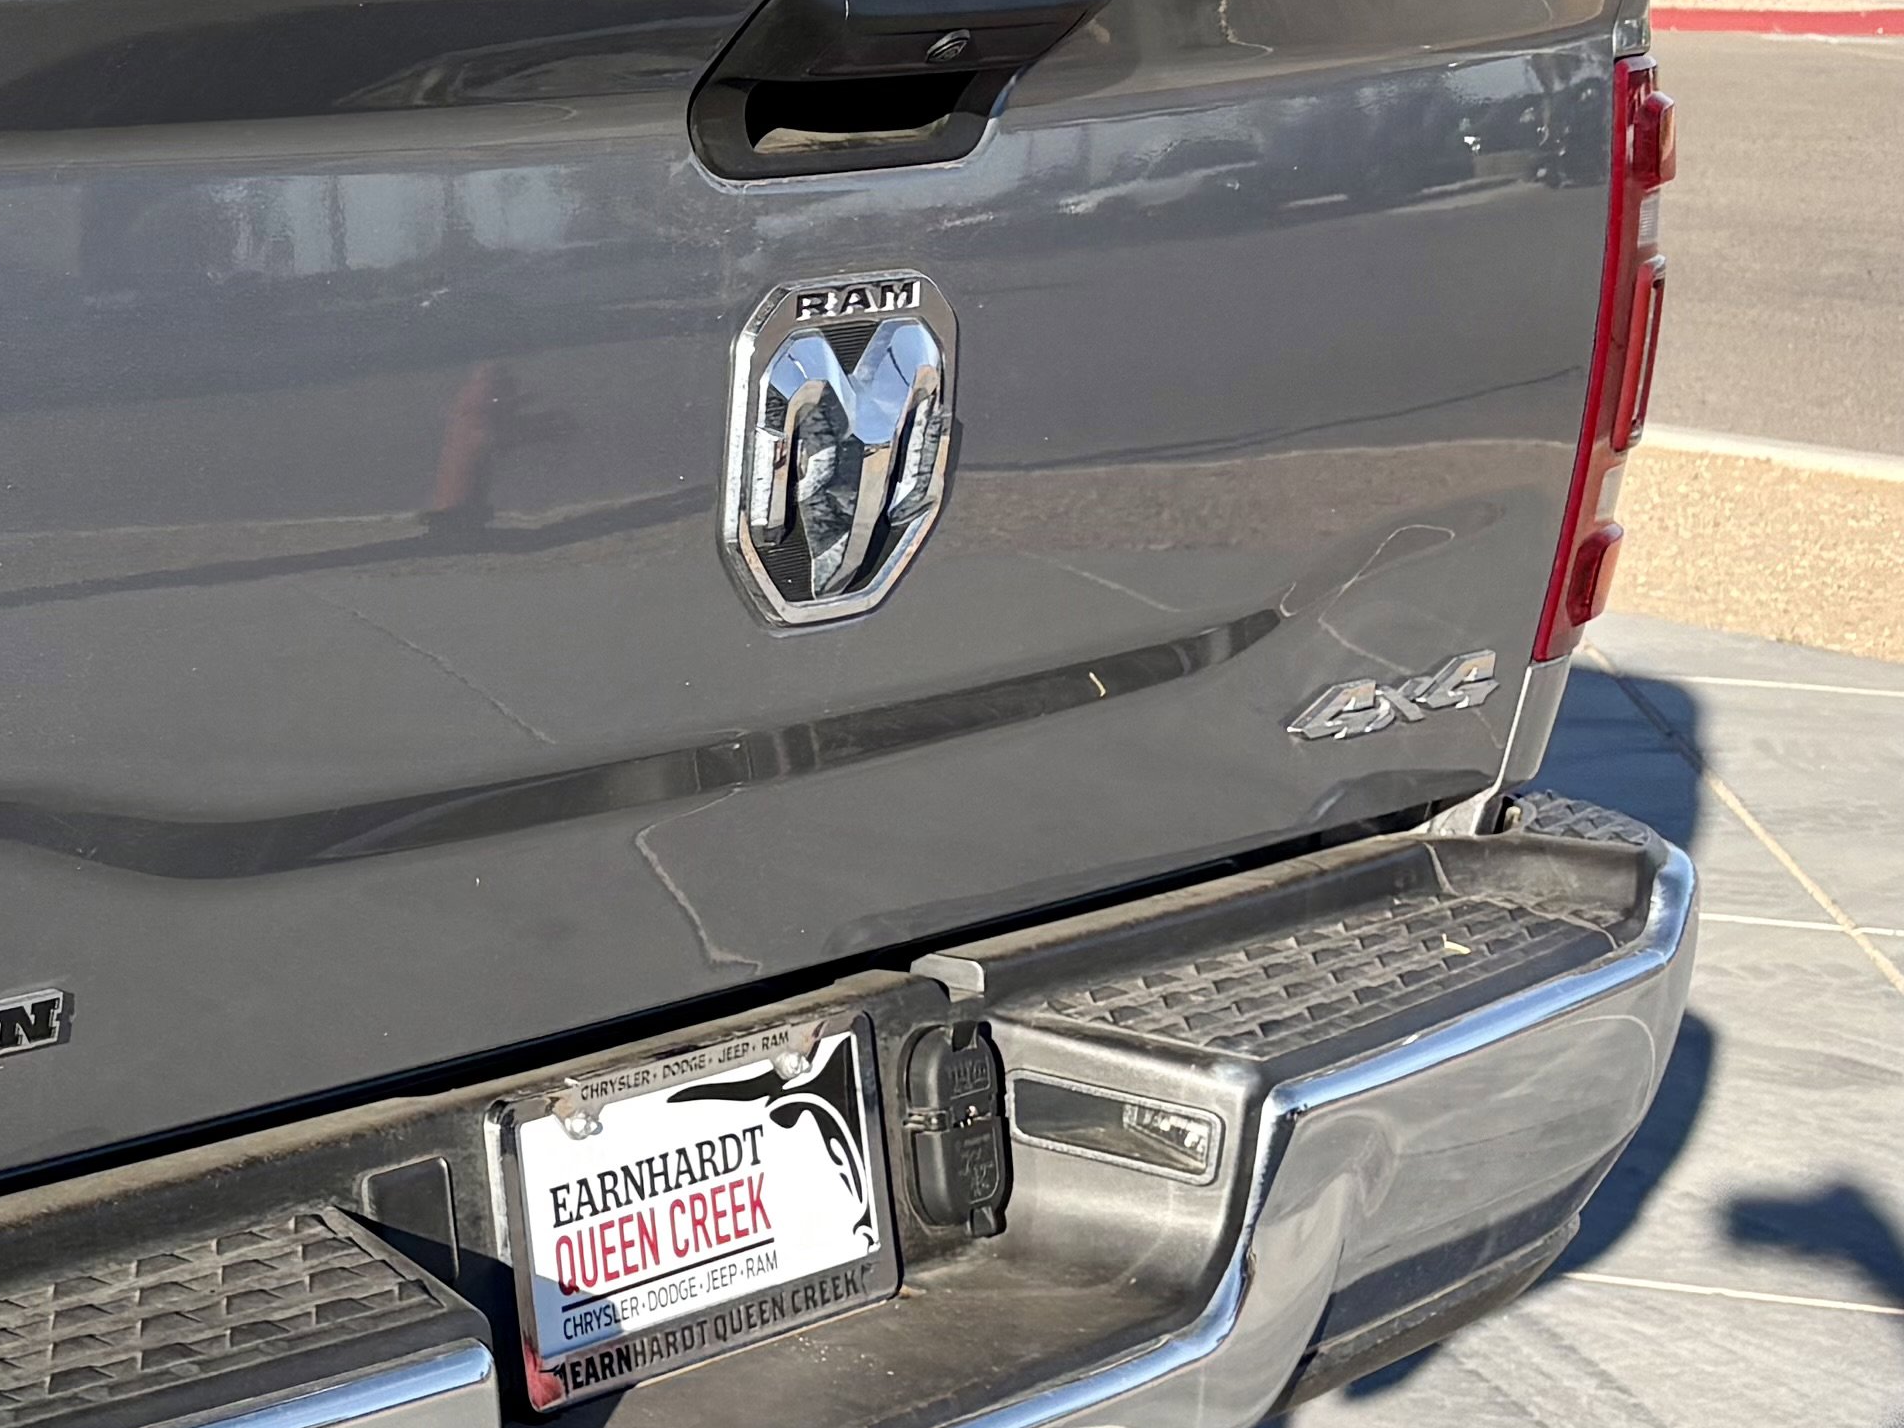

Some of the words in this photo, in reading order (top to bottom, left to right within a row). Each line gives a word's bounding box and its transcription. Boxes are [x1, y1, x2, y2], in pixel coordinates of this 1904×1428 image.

[796, 280, 921, 321] RAM
[580, 1071, 650, 1101] CHRYSLER
[662, 1054, 707, 1080] DODGE
[717, 1042, 749, 1064] JEEP
[761, 1030, 790, 1051] RAM
[549, 1124, 764, 1229] EARNHARDT
[555, 1207, 660, 1297] QUEEN
[669, 1172, 772, 1258] CREEK
[563, 1295, 639, 1340] CHRYSLER
[647, 1276, 698, 1312] DODGE
[705, 1263, 738, 1293] JEEP
[746, 1249, 779, 1280] RAM
[571, 1319, 708, 1391] EARNHARDT
[715, 1295, 786, 1342] QUEEN
[791, 1269, 861, 1315] CREEK
